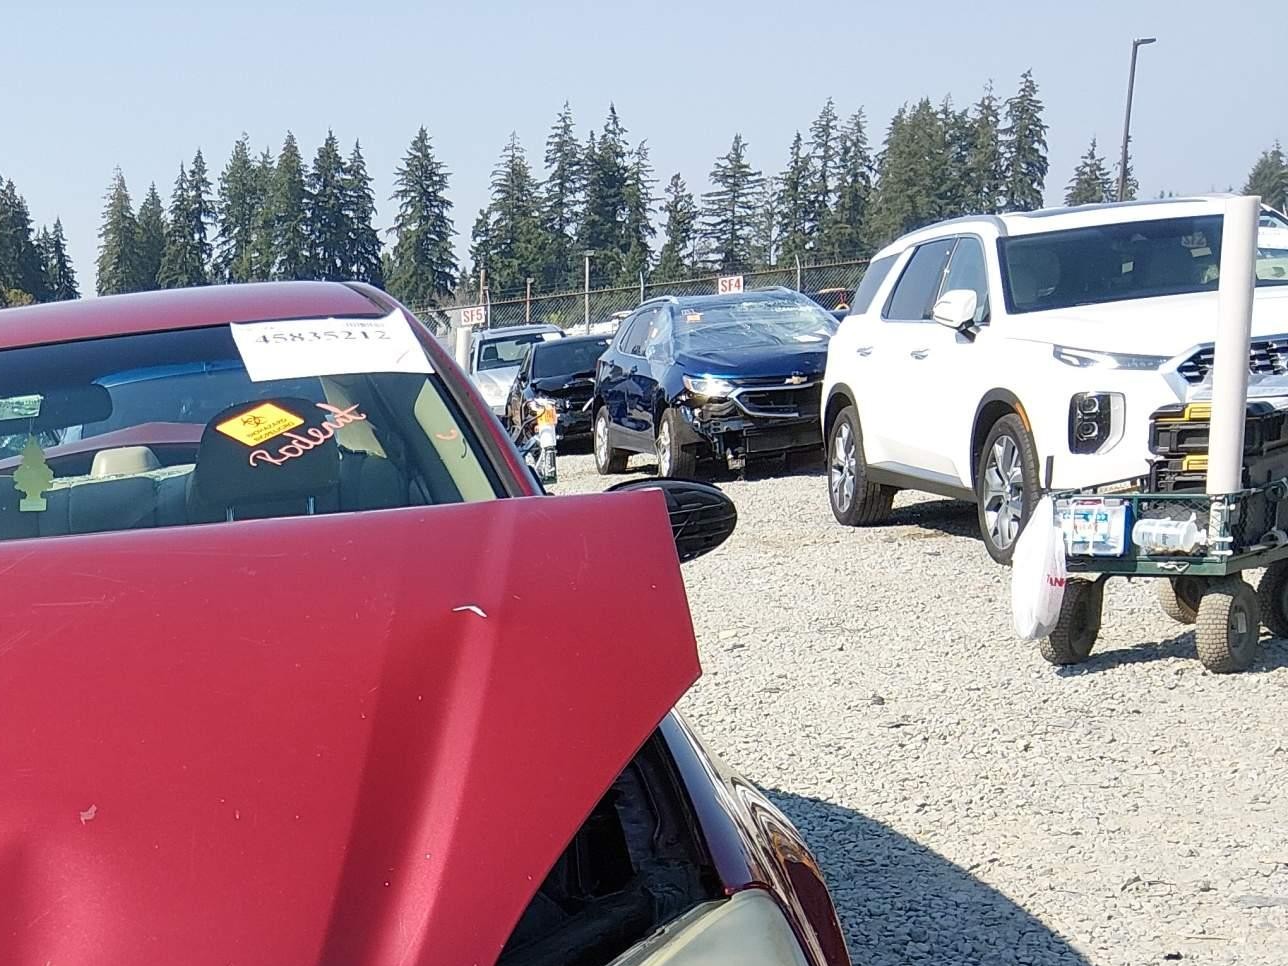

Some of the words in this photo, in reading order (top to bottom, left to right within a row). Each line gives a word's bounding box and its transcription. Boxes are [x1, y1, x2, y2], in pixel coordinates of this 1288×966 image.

[721, 278, 741, 292] SF4
[463, 308, 482, 323] SF5
[255, 330, 393, 345] 45835212
[249, 402, 367, 466] Rodent
